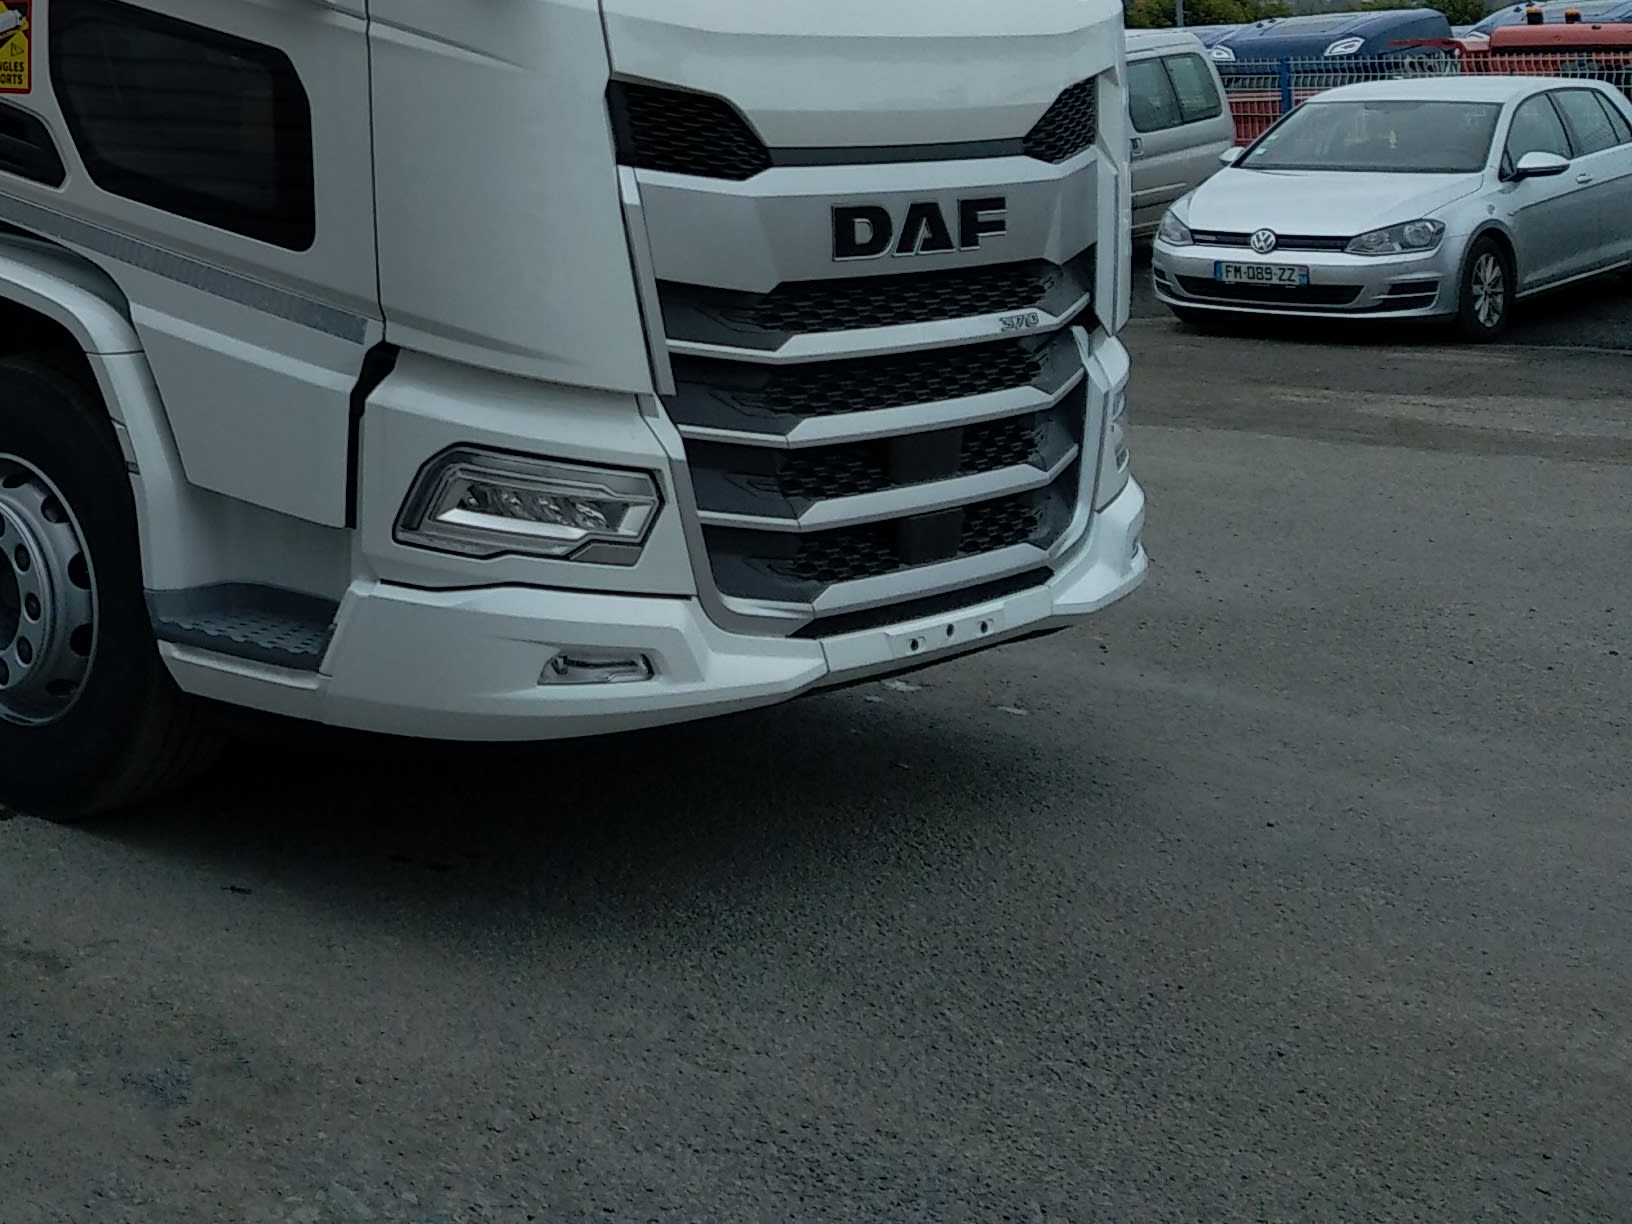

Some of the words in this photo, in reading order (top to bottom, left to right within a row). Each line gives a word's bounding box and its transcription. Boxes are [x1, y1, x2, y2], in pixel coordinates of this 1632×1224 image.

[831, 196, 1008, 262] DAF
[1224, 264, 1296, 283] FM-089-ZZ
[999, 312, 1039, 332] 370
